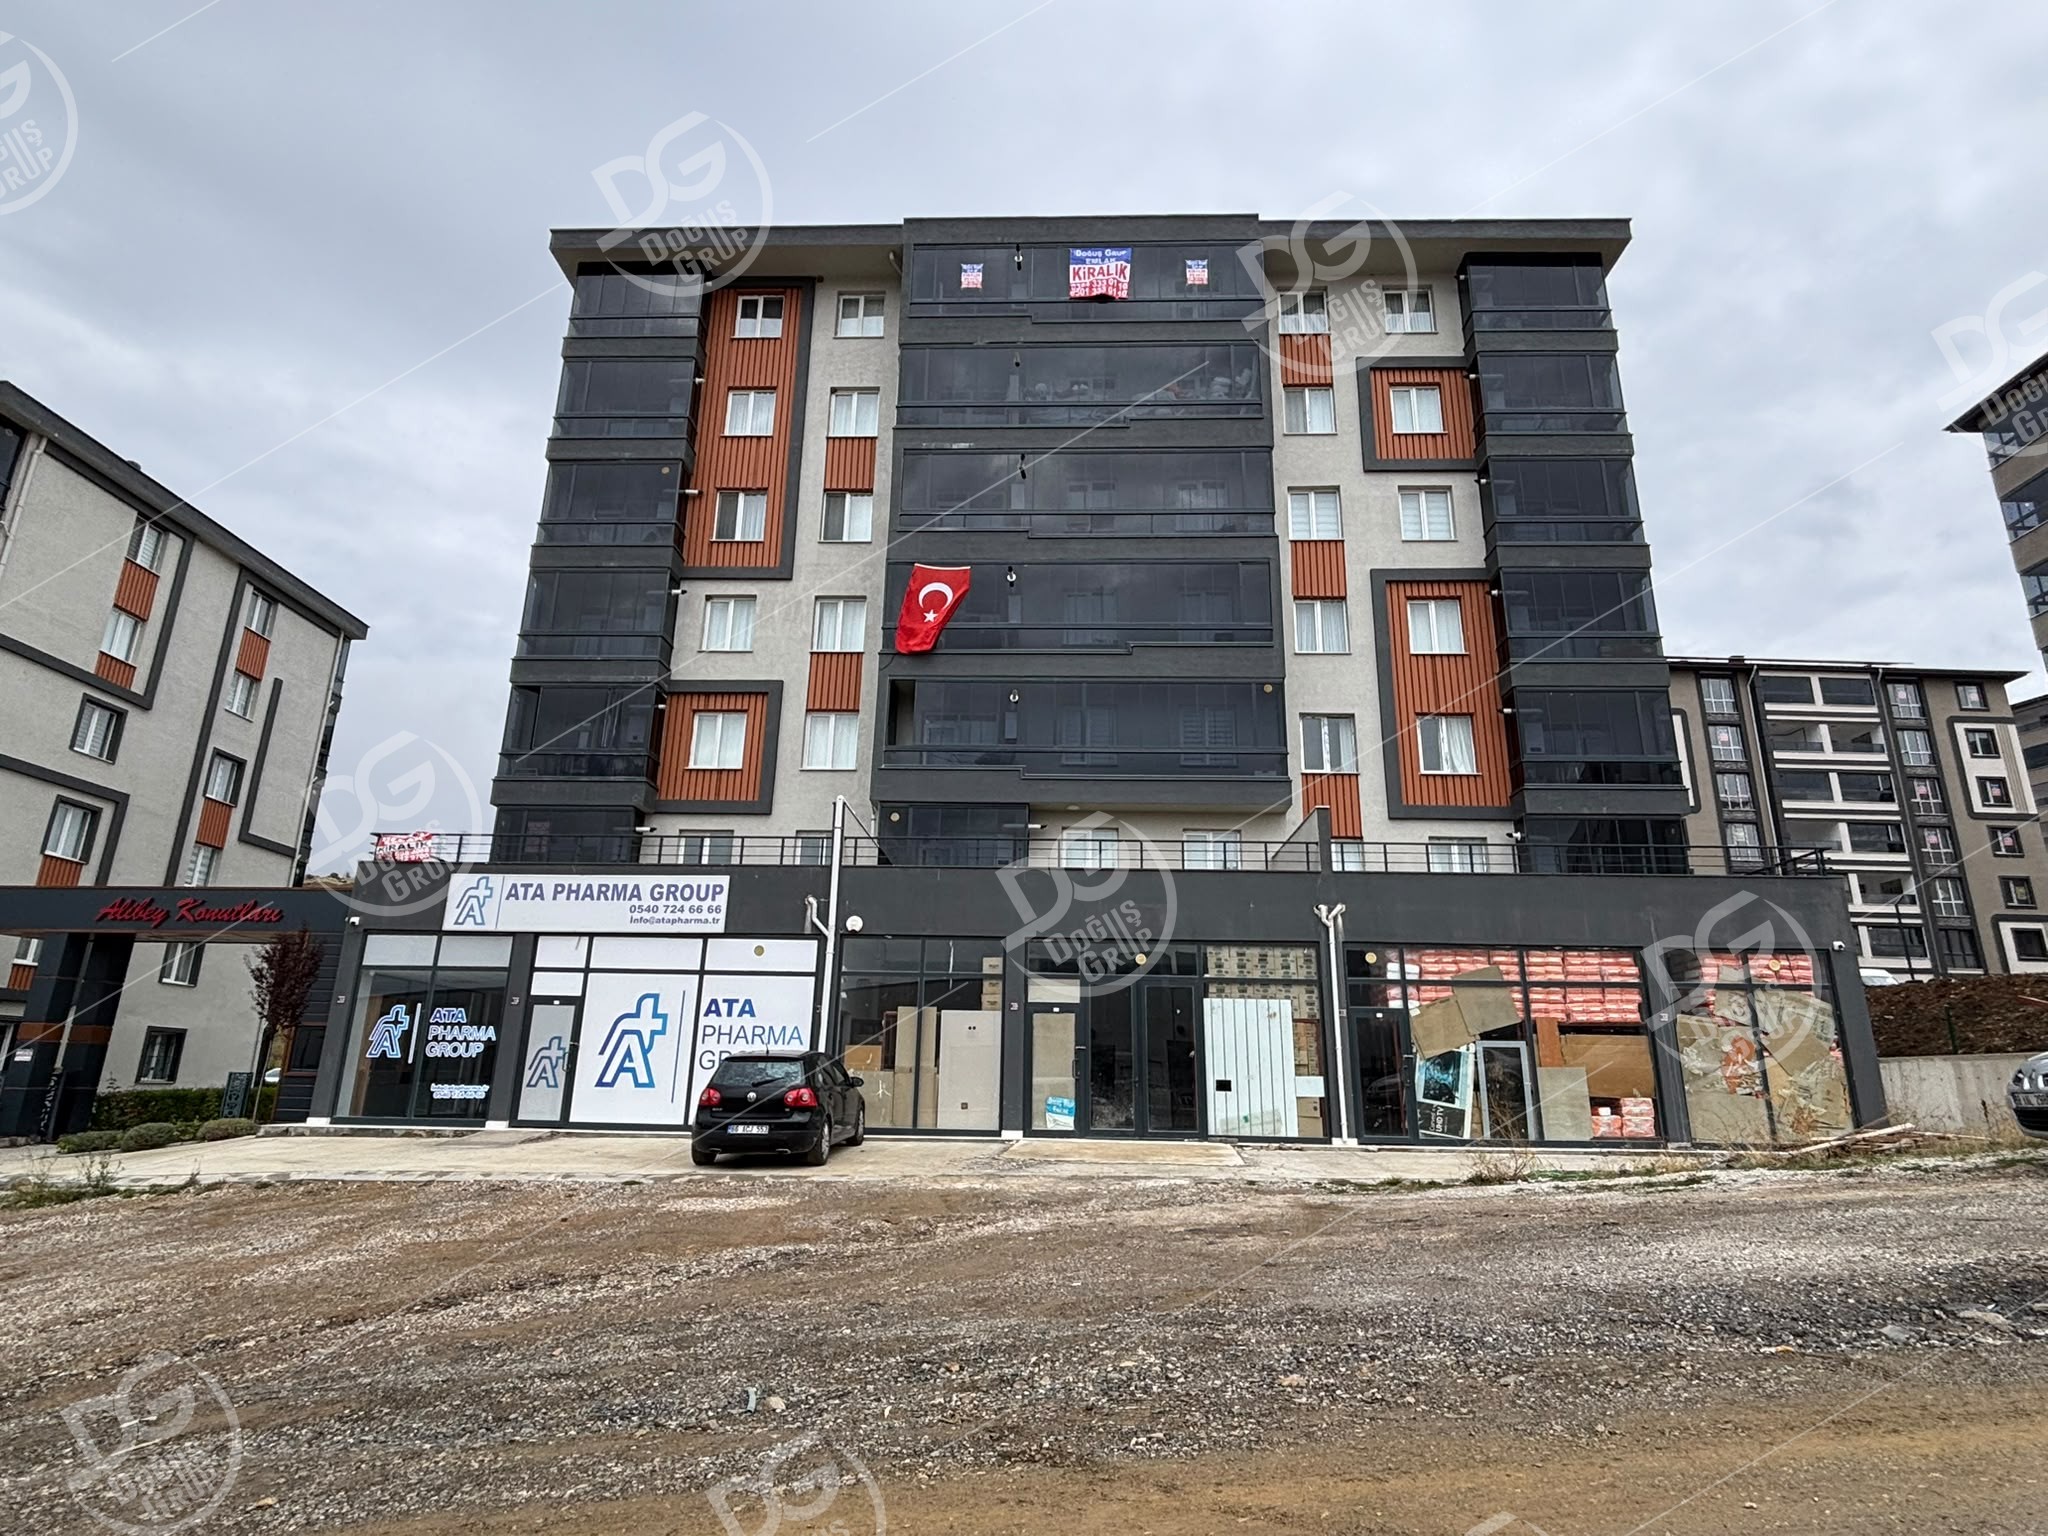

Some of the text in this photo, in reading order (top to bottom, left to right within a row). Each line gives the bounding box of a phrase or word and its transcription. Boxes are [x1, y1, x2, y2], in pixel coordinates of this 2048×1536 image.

[504, 882, 725, 902] ATA PHARMA GROUP
[629, 904, 722, 914] 0540 724 66 66
[430, 1007, 467, 1023] ATA
[703, 998, 757, 1018] ATA
[427, 1025, 497, 1041] PHARMA
[701, 1024, 804, 1046] PHARMA
[425, 1041, 485, 1058] GROUP
